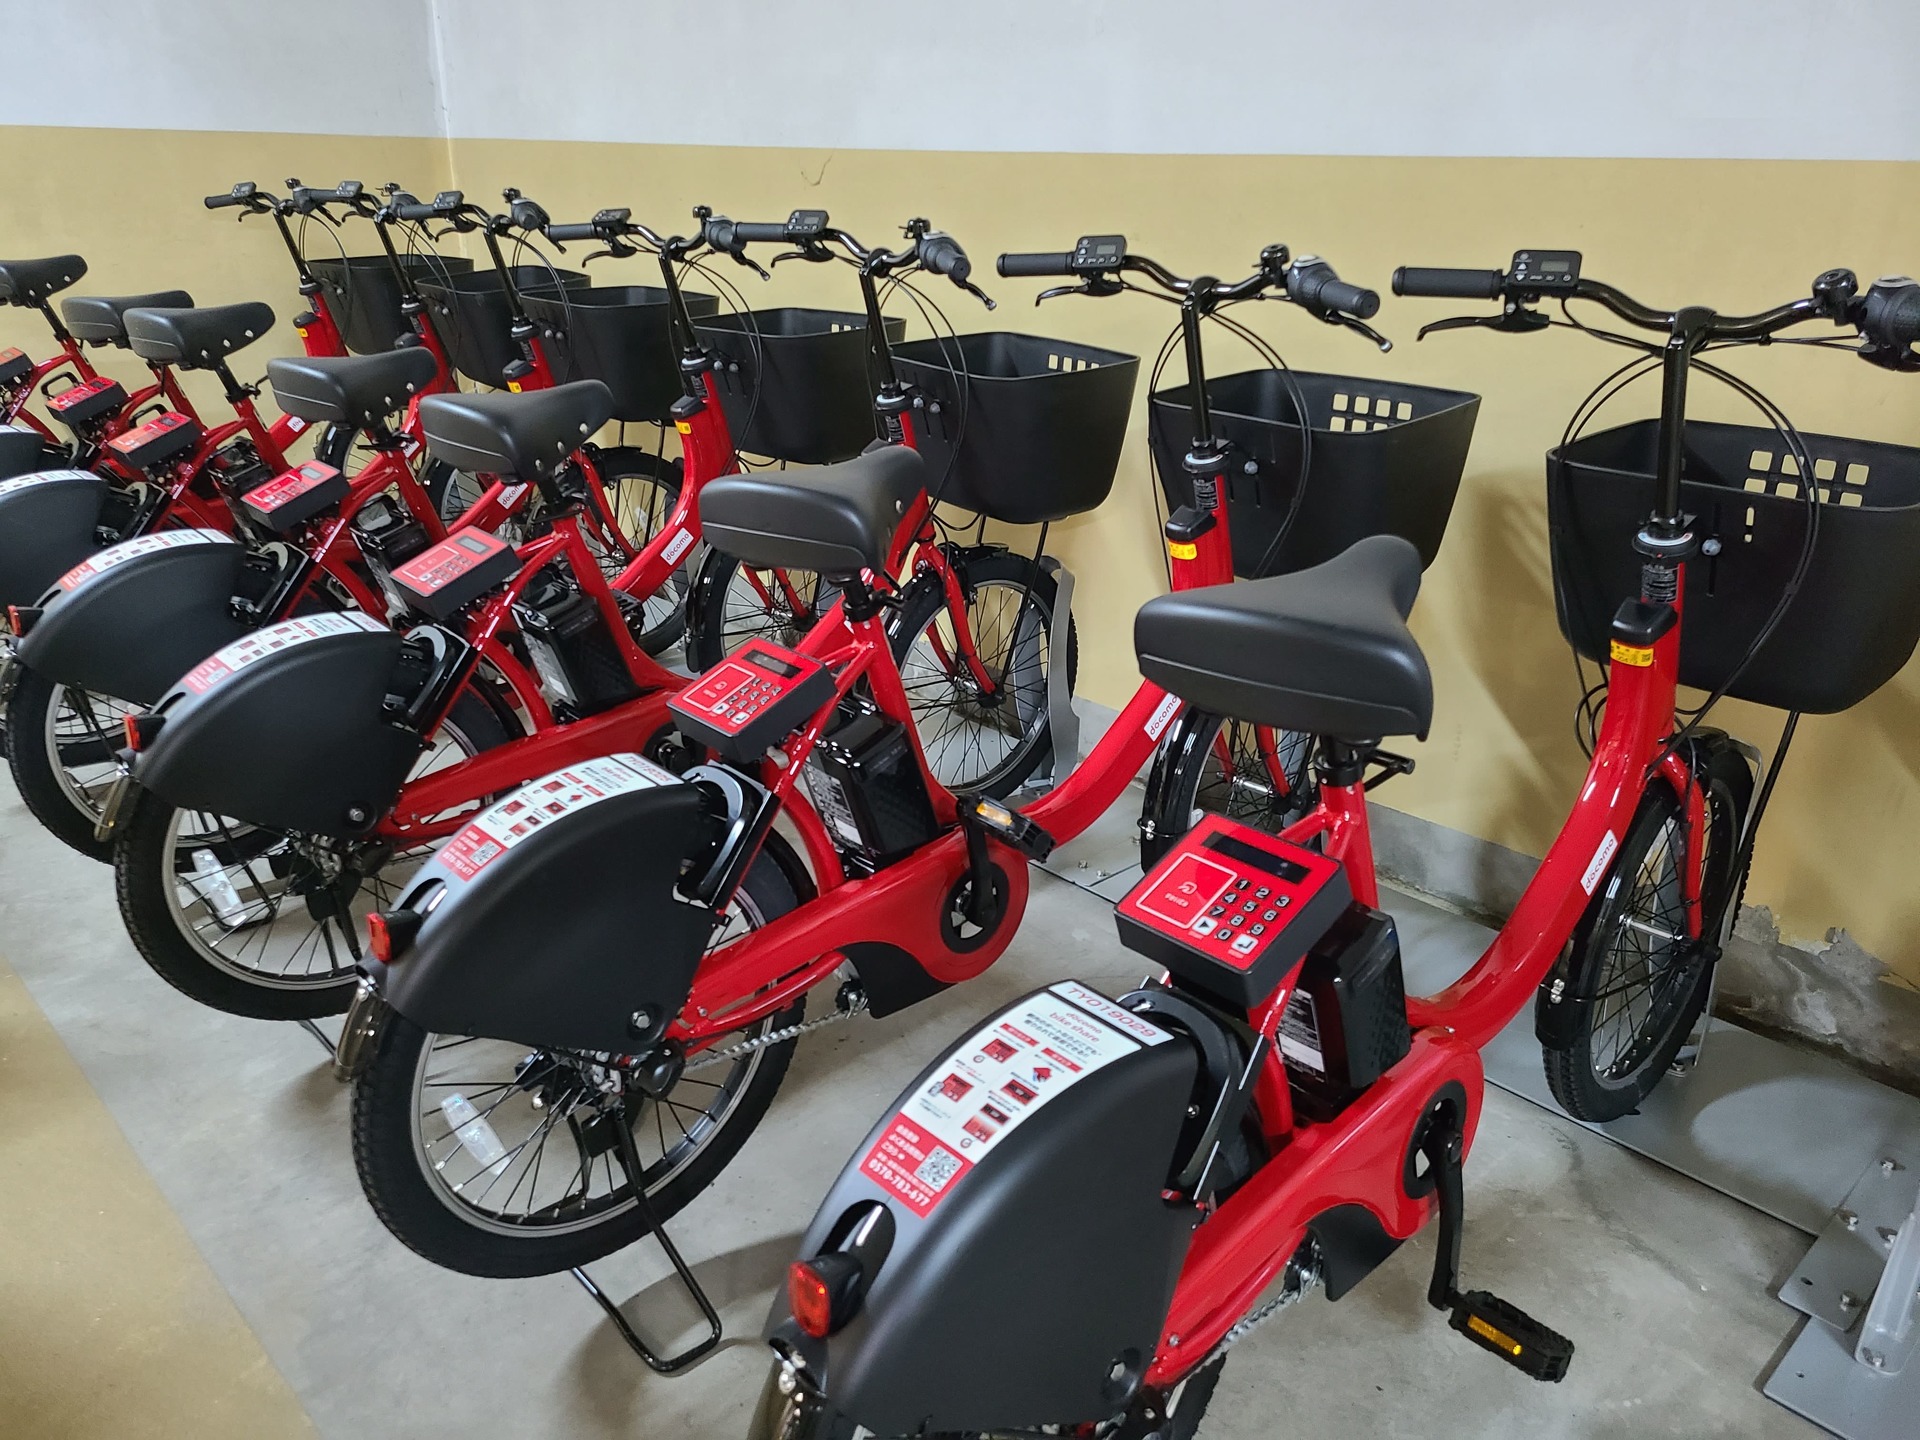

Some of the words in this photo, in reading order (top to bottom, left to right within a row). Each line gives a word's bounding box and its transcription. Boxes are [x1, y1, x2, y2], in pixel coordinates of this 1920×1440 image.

[1223, 892, 1237, 904] 4
[1243, 900, 1257, 912] 5
[1263, 909, 1277, 922] 6
[1238, 879, 1249, 890] 1
[1255, 887, 1270, 899] 2
[1275, 895, 1290, 908] 3
[1210, 905, 1225, 917] 7
[1230, 914, 1245, 927] 8
[1250, 923, 1265, 936] 9
[1217, 928, 1232, 941] 0
[1049, 1012, 1072, 1027] bike
[1071, 1024, 1100, 1043] share
[867, 1158, 931, 1207] 0570-783-677
